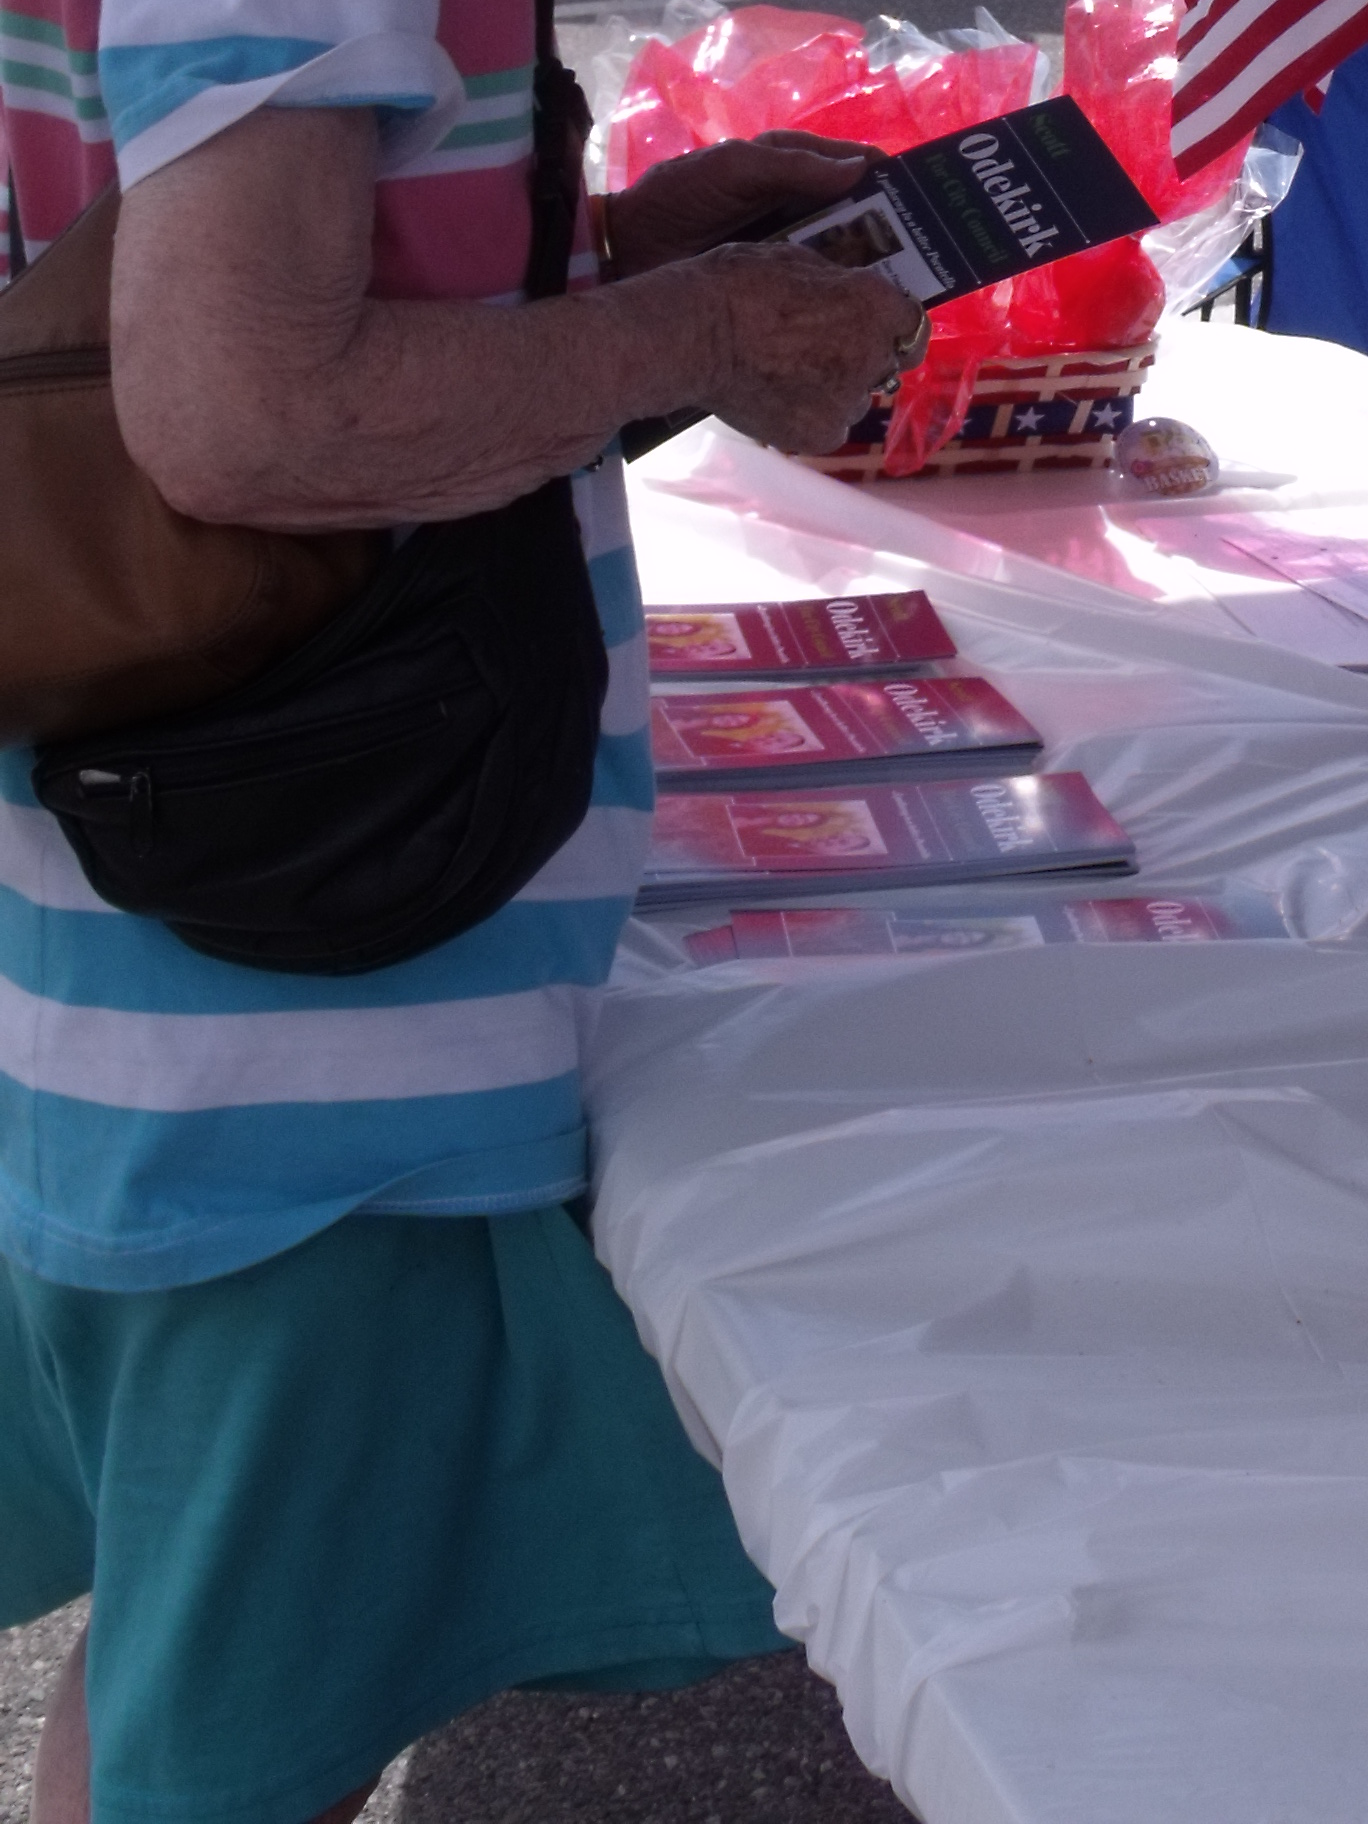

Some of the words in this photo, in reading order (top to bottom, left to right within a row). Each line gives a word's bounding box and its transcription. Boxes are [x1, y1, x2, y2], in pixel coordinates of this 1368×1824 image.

[958, 132, 1060, 259] Odekirk
[826, 600, 879, 659] Odekirk
[884, 683, 958, 746] Odekirk
[970, 783, 1034, 853] Odekirk
